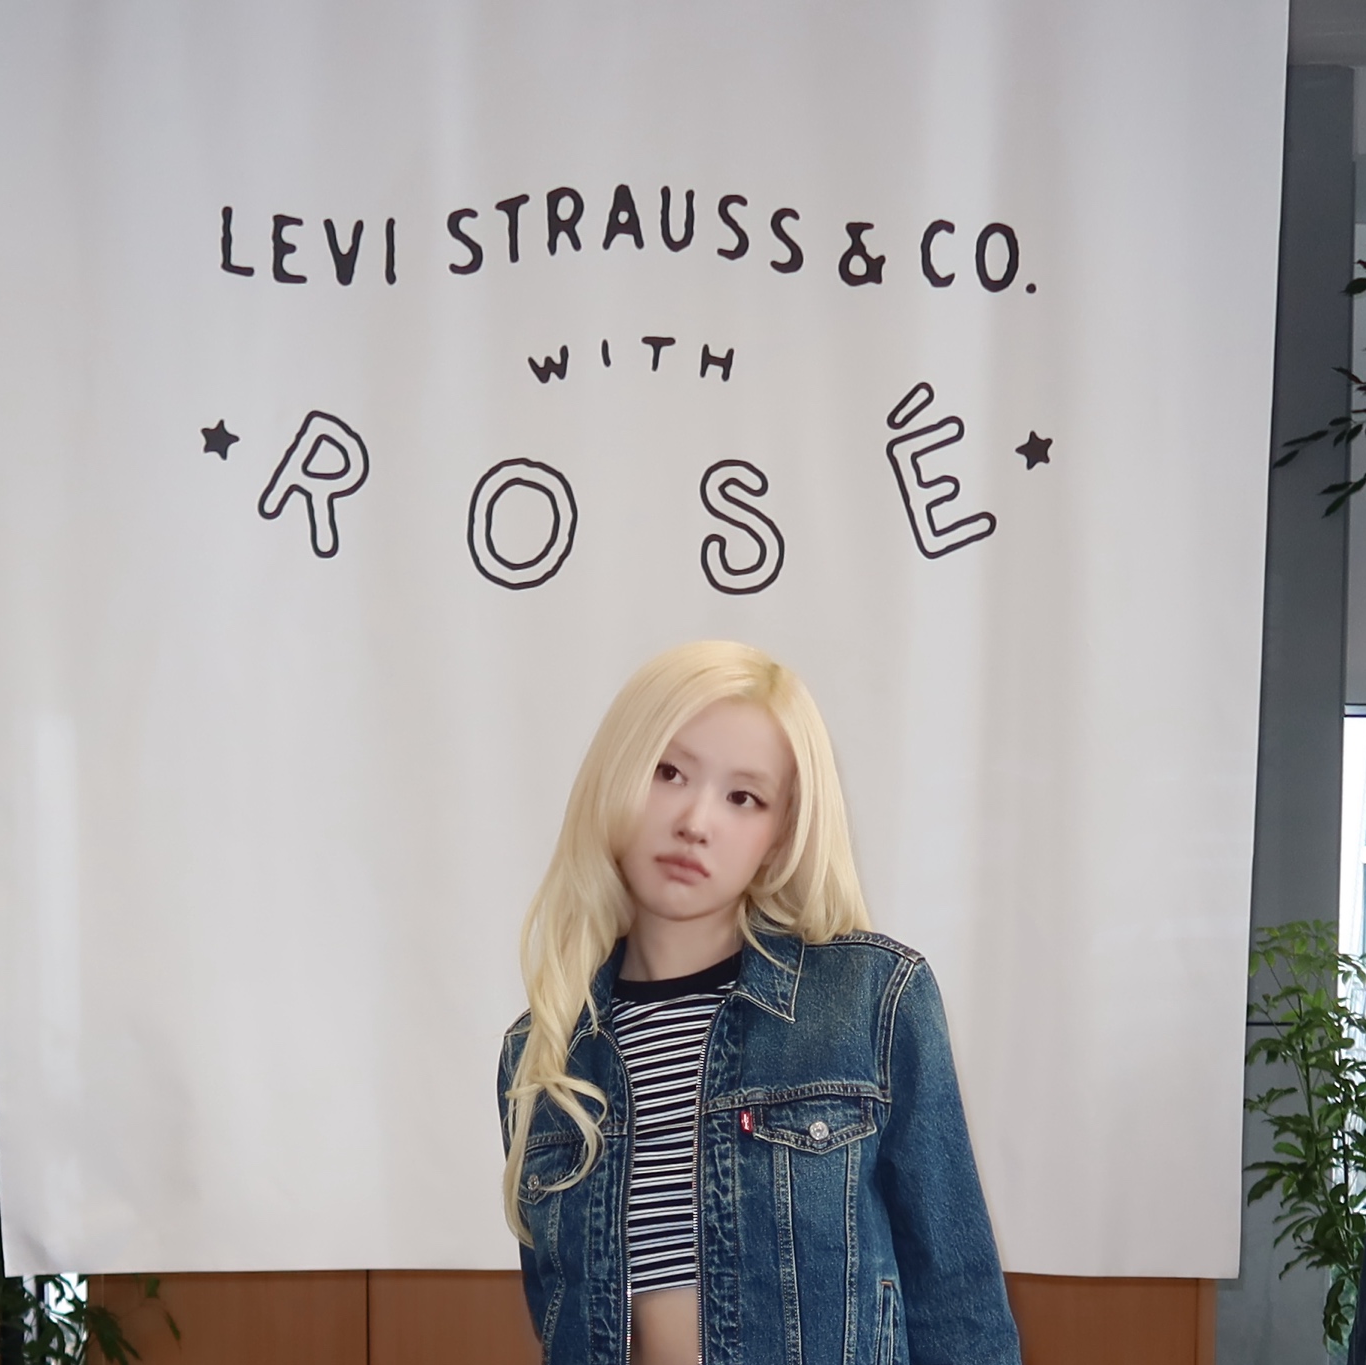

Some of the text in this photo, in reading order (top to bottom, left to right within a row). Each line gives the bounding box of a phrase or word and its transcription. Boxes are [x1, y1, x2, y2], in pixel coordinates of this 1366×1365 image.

[219, 183, 1037, 295] LEVI STRAUSS & CO.
[527, 335, 735, 384] WITH
[257, 381, 998, 597] ROSÉ
